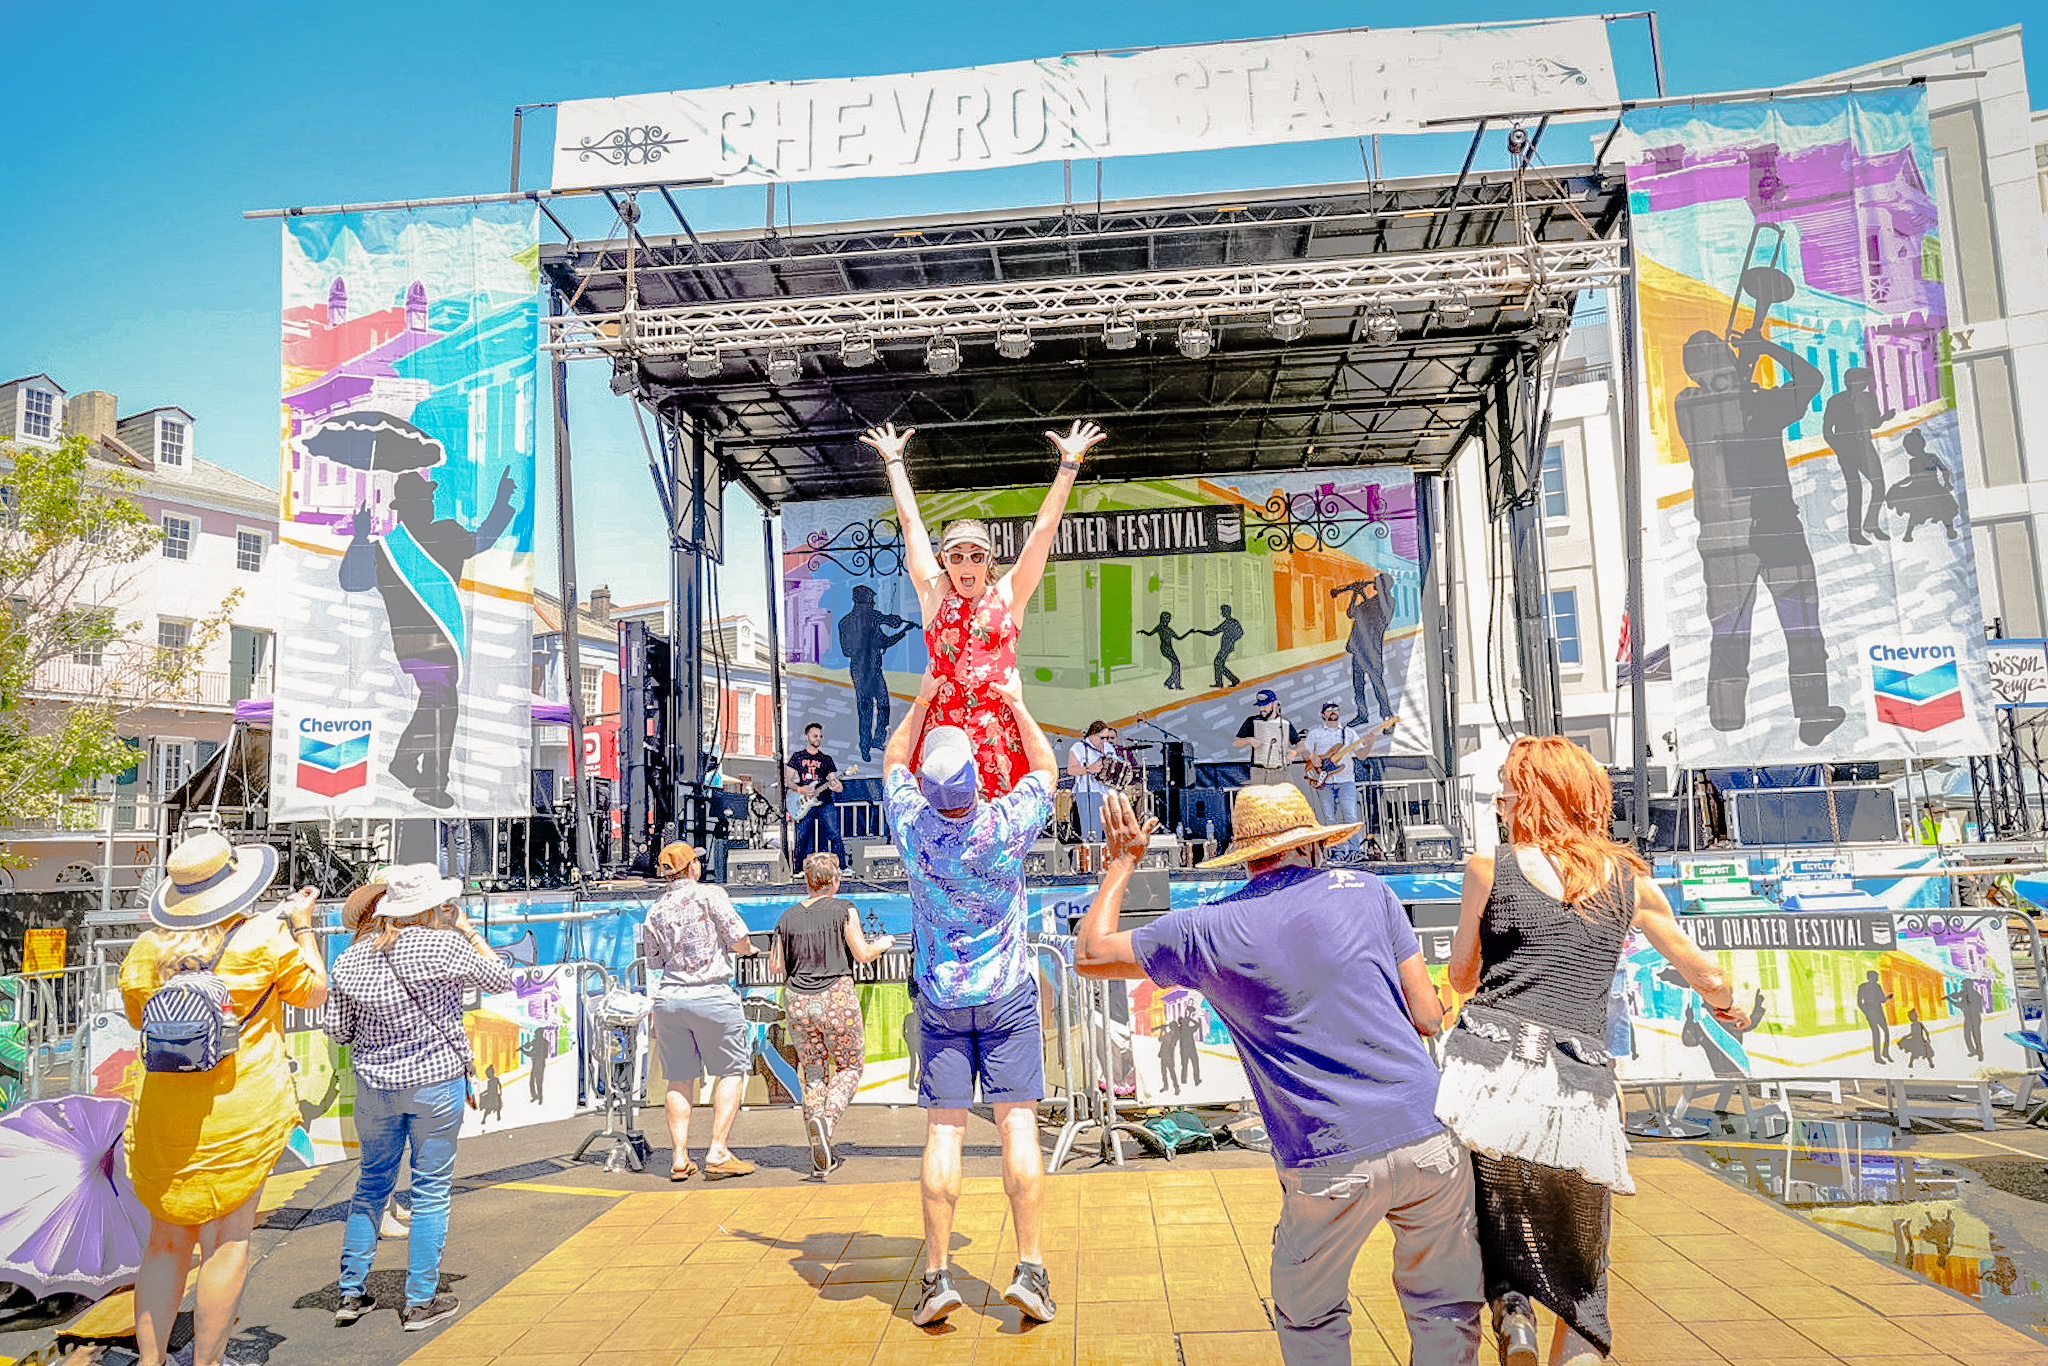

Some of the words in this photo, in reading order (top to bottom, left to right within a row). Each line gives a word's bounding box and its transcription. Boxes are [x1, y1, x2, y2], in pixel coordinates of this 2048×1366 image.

[710, 72, 1112, 177] CHEVRON
[1116, 511, 1209, 551] FESTIVAL
[1869, 644, 1956, 661] Chevron
[1988, 653, 2044, 676] oisson
[299, 717, 372, 732] Chevron
[1680, 918, 1717, 947] ENCH
[1721, 918, 1790, 949] QUARTER
[1794, 917, 1866, 947] FESTIVAL
